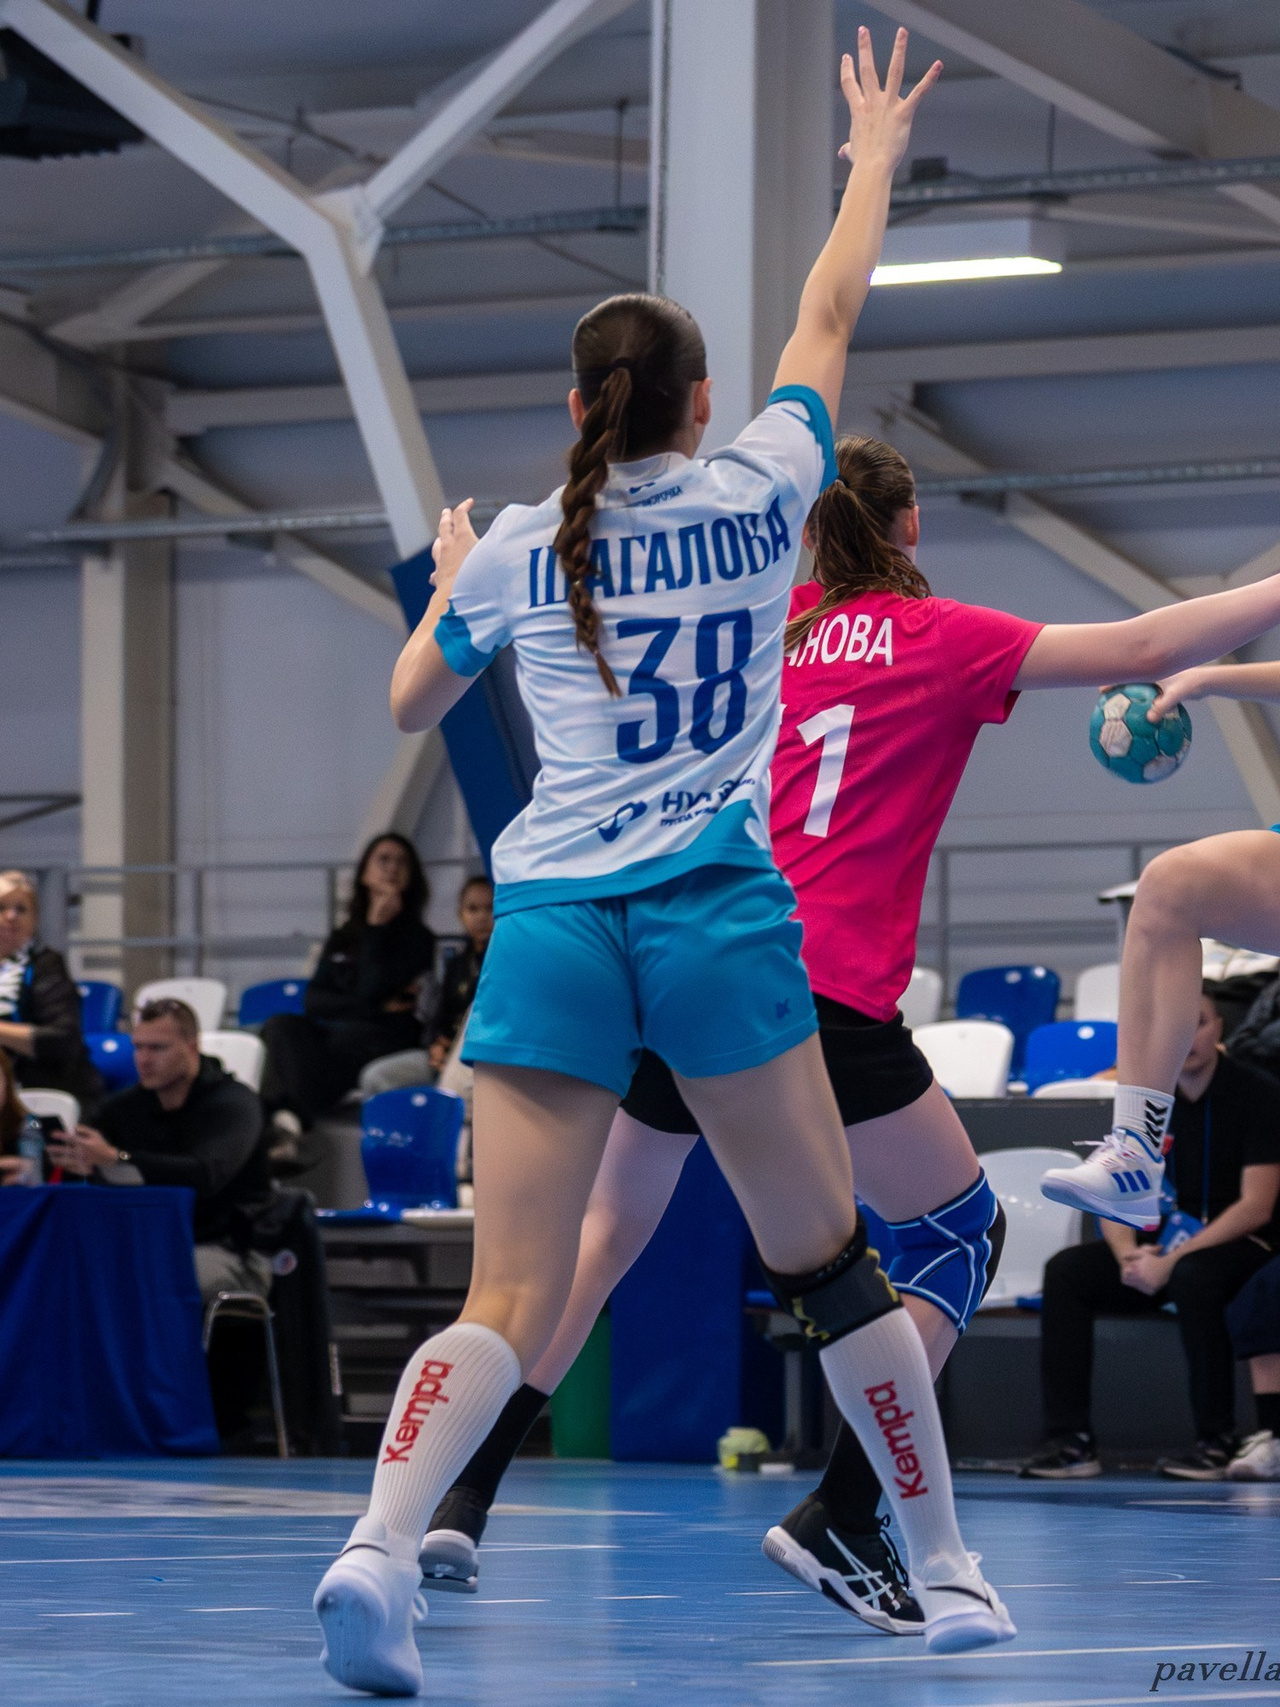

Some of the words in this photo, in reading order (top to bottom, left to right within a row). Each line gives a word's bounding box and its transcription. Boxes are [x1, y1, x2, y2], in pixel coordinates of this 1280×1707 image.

[616, 608, 752, 764] 38
[382, 1360, 455, 1464] Kempa
[863, 1380, 928, 1499] Kempa
